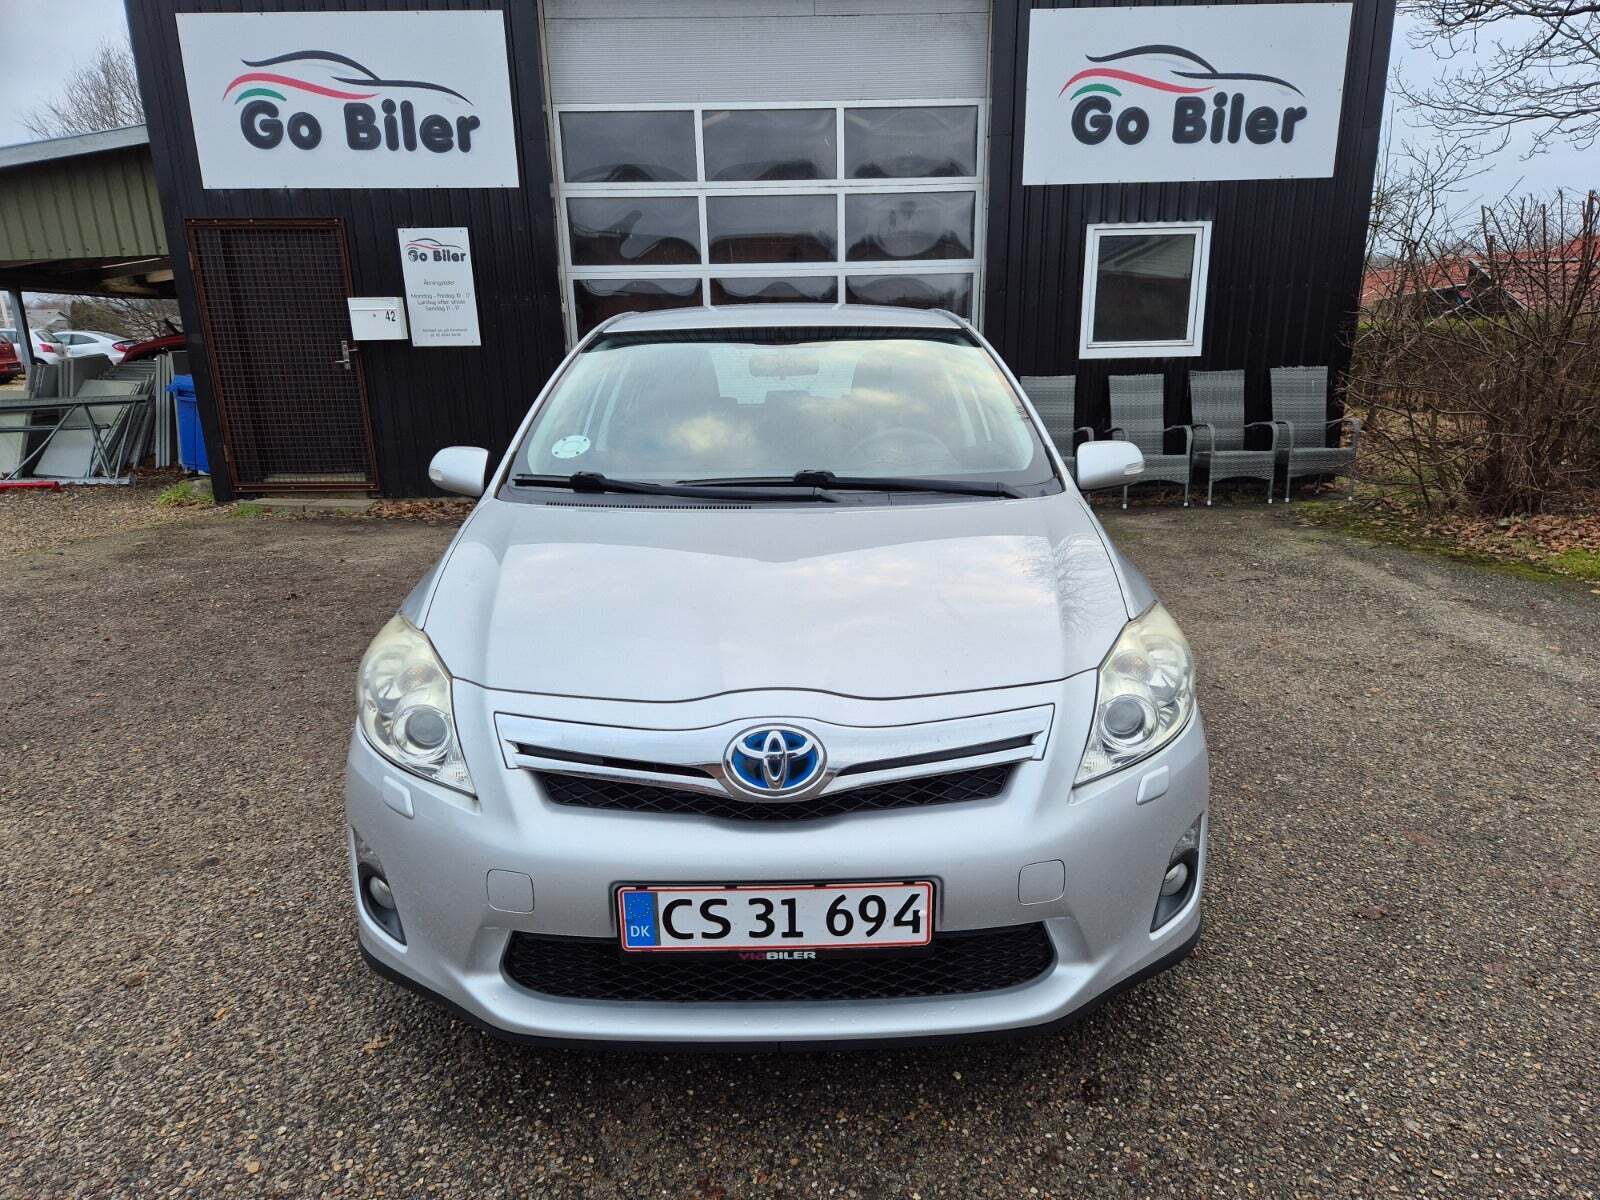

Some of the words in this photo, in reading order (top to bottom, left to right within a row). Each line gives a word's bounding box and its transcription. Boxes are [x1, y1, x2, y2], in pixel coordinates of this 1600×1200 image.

[240, 99, 322, 150] Go
[343, 98, 481, 153] Biler
[1071, 94, 1150, 146] Go
[1171, 91, 1308, 145] Biler
[407, 249, 428, 262] Go
[433, 249, 466, 262] Biler
[385, 310, 396, 322] 42
[630, 925, 650, 937] DK
[661, 898, 732, 940] CS
[748, 897, 804, 939] 31
[825, 893, 921, 938] 694
